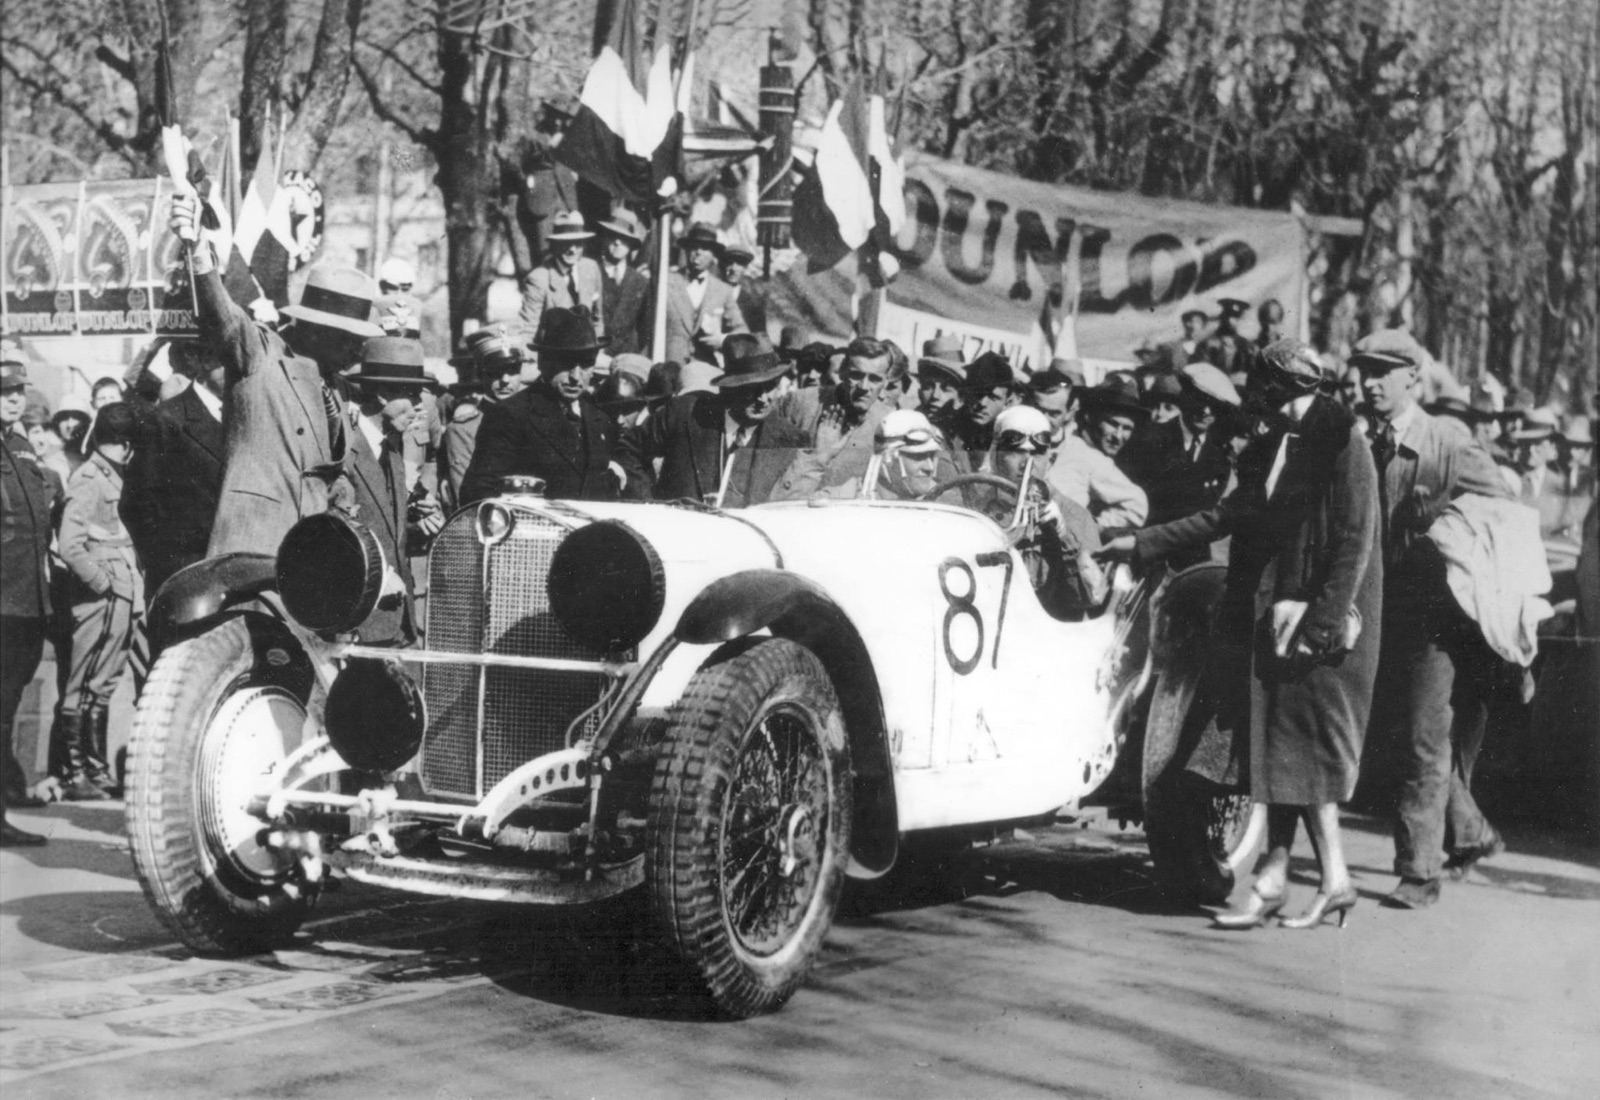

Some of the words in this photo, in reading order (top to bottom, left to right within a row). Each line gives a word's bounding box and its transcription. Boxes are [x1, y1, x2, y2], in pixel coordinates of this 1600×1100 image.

[894, 178, 1258, 314] DUNLOP
[7, 311, 75, 333] DUNLOP
[79, 309, 153, 331] DUNLOP
[156, 309, 199, 329] DUN
[938, 550, 1014, 676] 87
